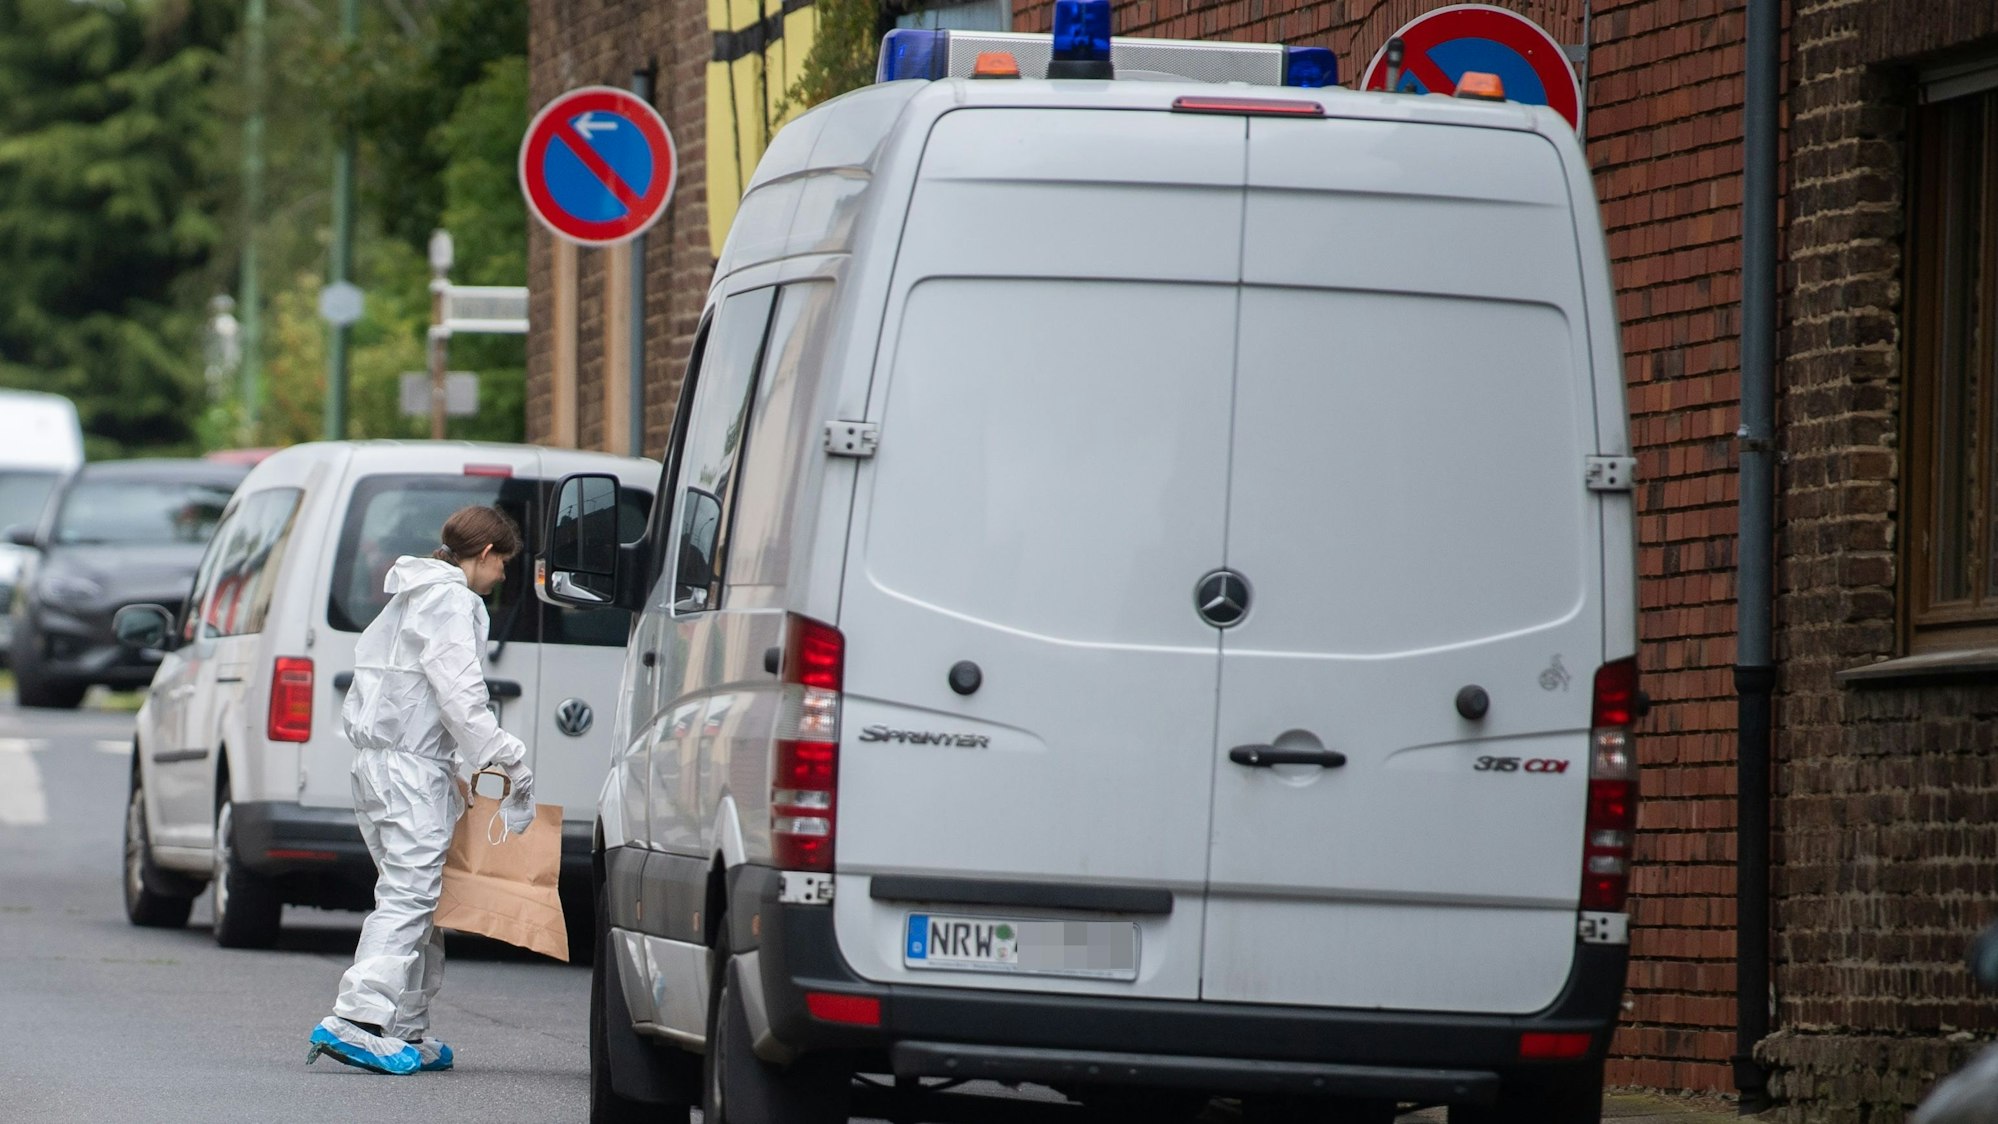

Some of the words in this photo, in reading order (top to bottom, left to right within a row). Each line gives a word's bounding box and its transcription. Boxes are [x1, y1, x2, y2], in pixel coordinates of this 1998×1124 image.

[556, 698, 593, 736] VW
[858, 725, 989, 748] SPRINTER
[1473, 756, 1521, 772] 315
[1523, 758, 1570, 774] CDI
[930, 921, 995, 957] NRW
